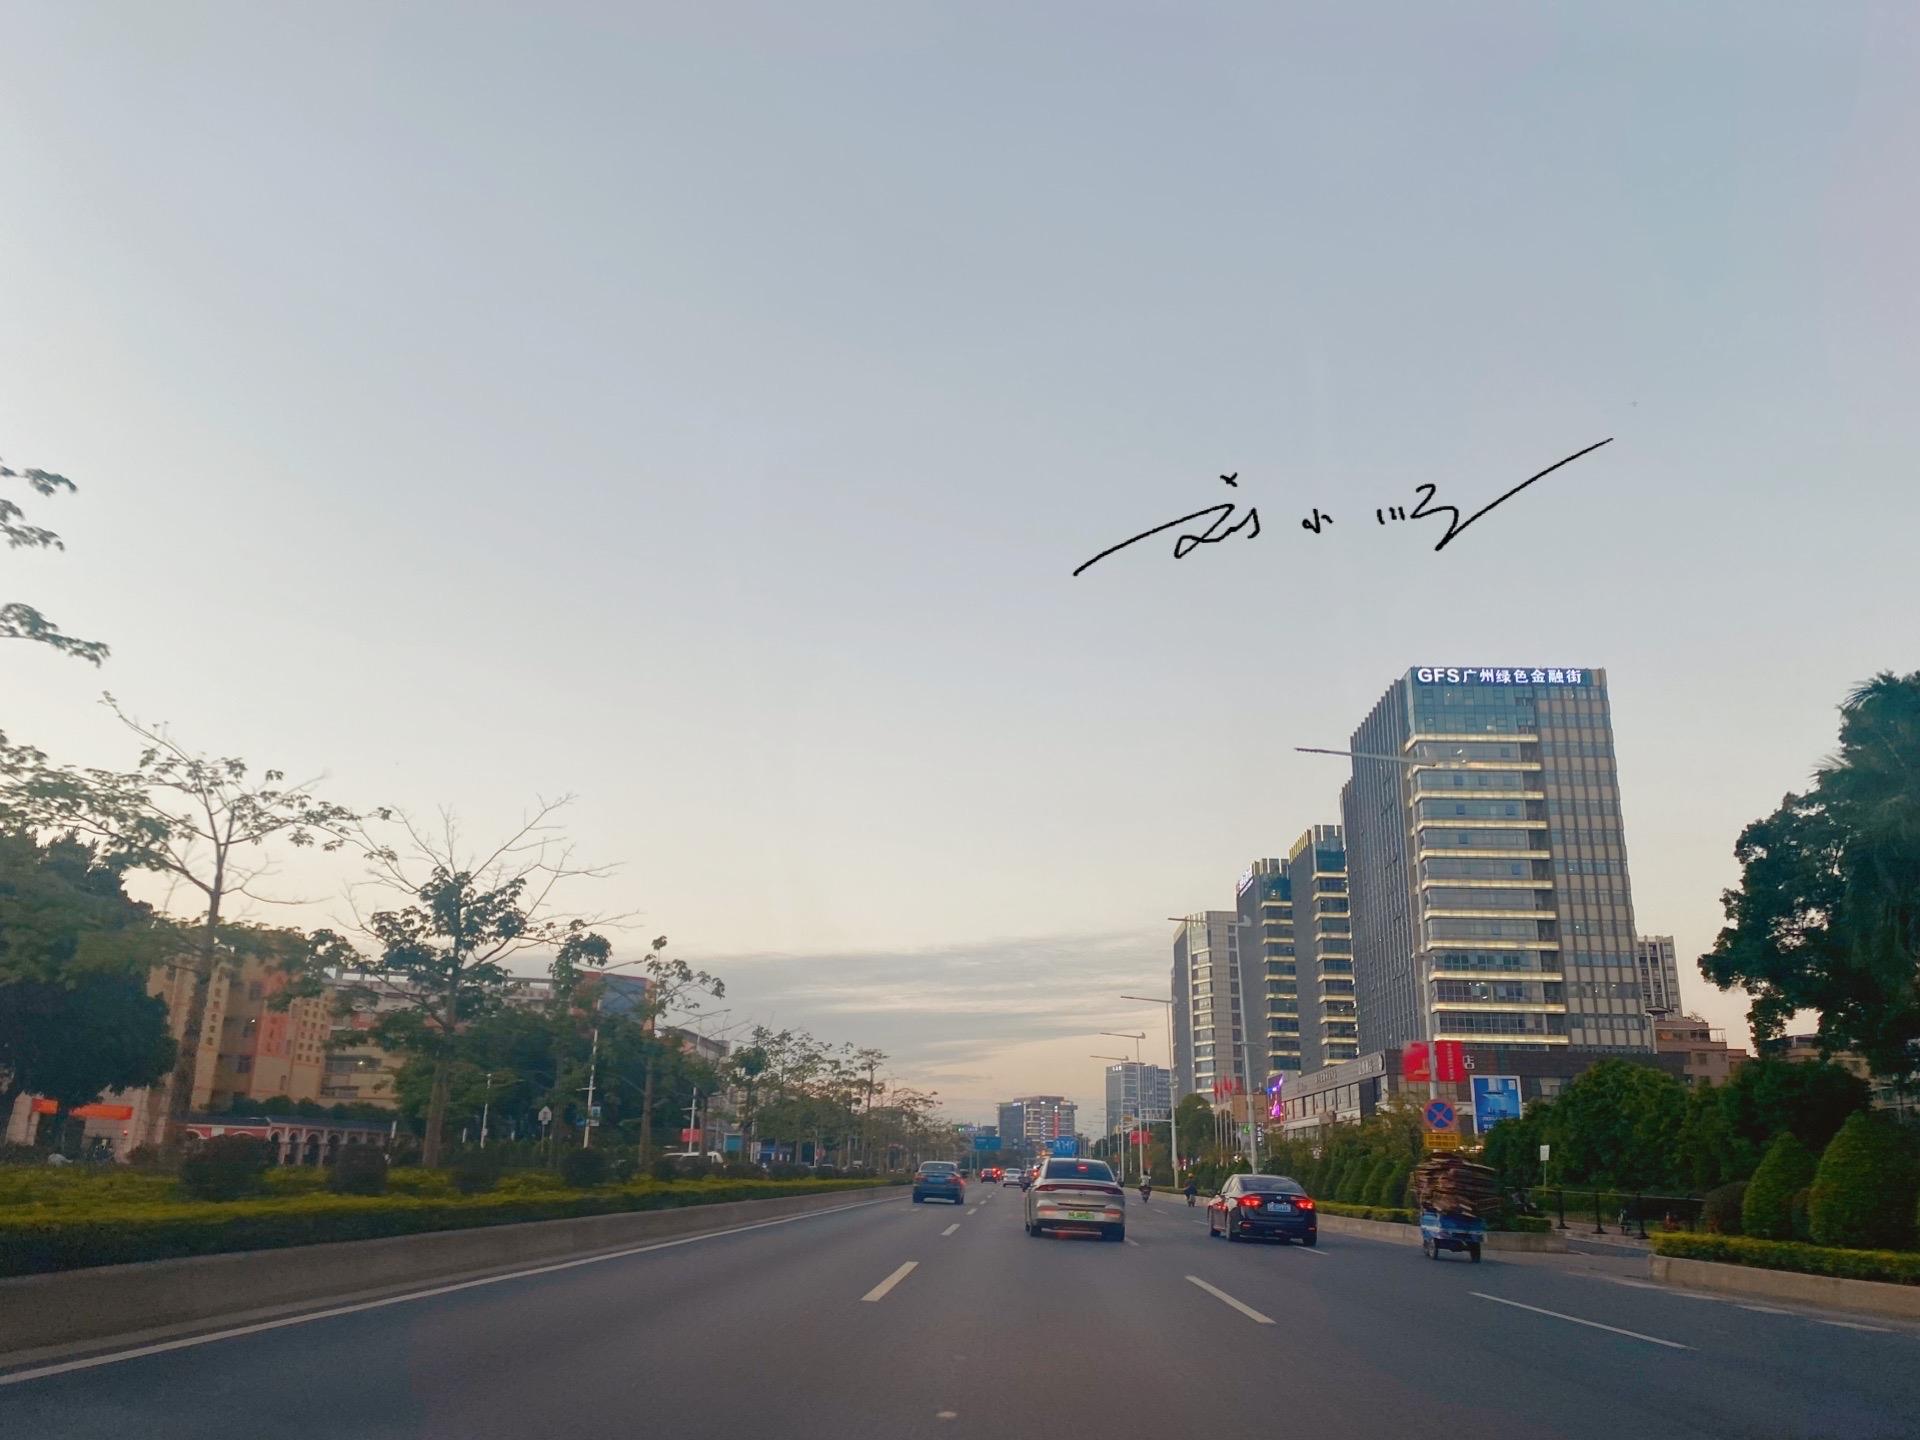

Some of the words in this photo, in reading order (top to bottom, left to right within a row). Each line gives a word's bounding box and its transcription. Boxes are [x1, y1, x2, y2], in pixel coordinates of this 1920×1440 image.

[1417, 668, 1460, 683] GFS
[1462, 668, 1582, 684] 广州绿色金融街
